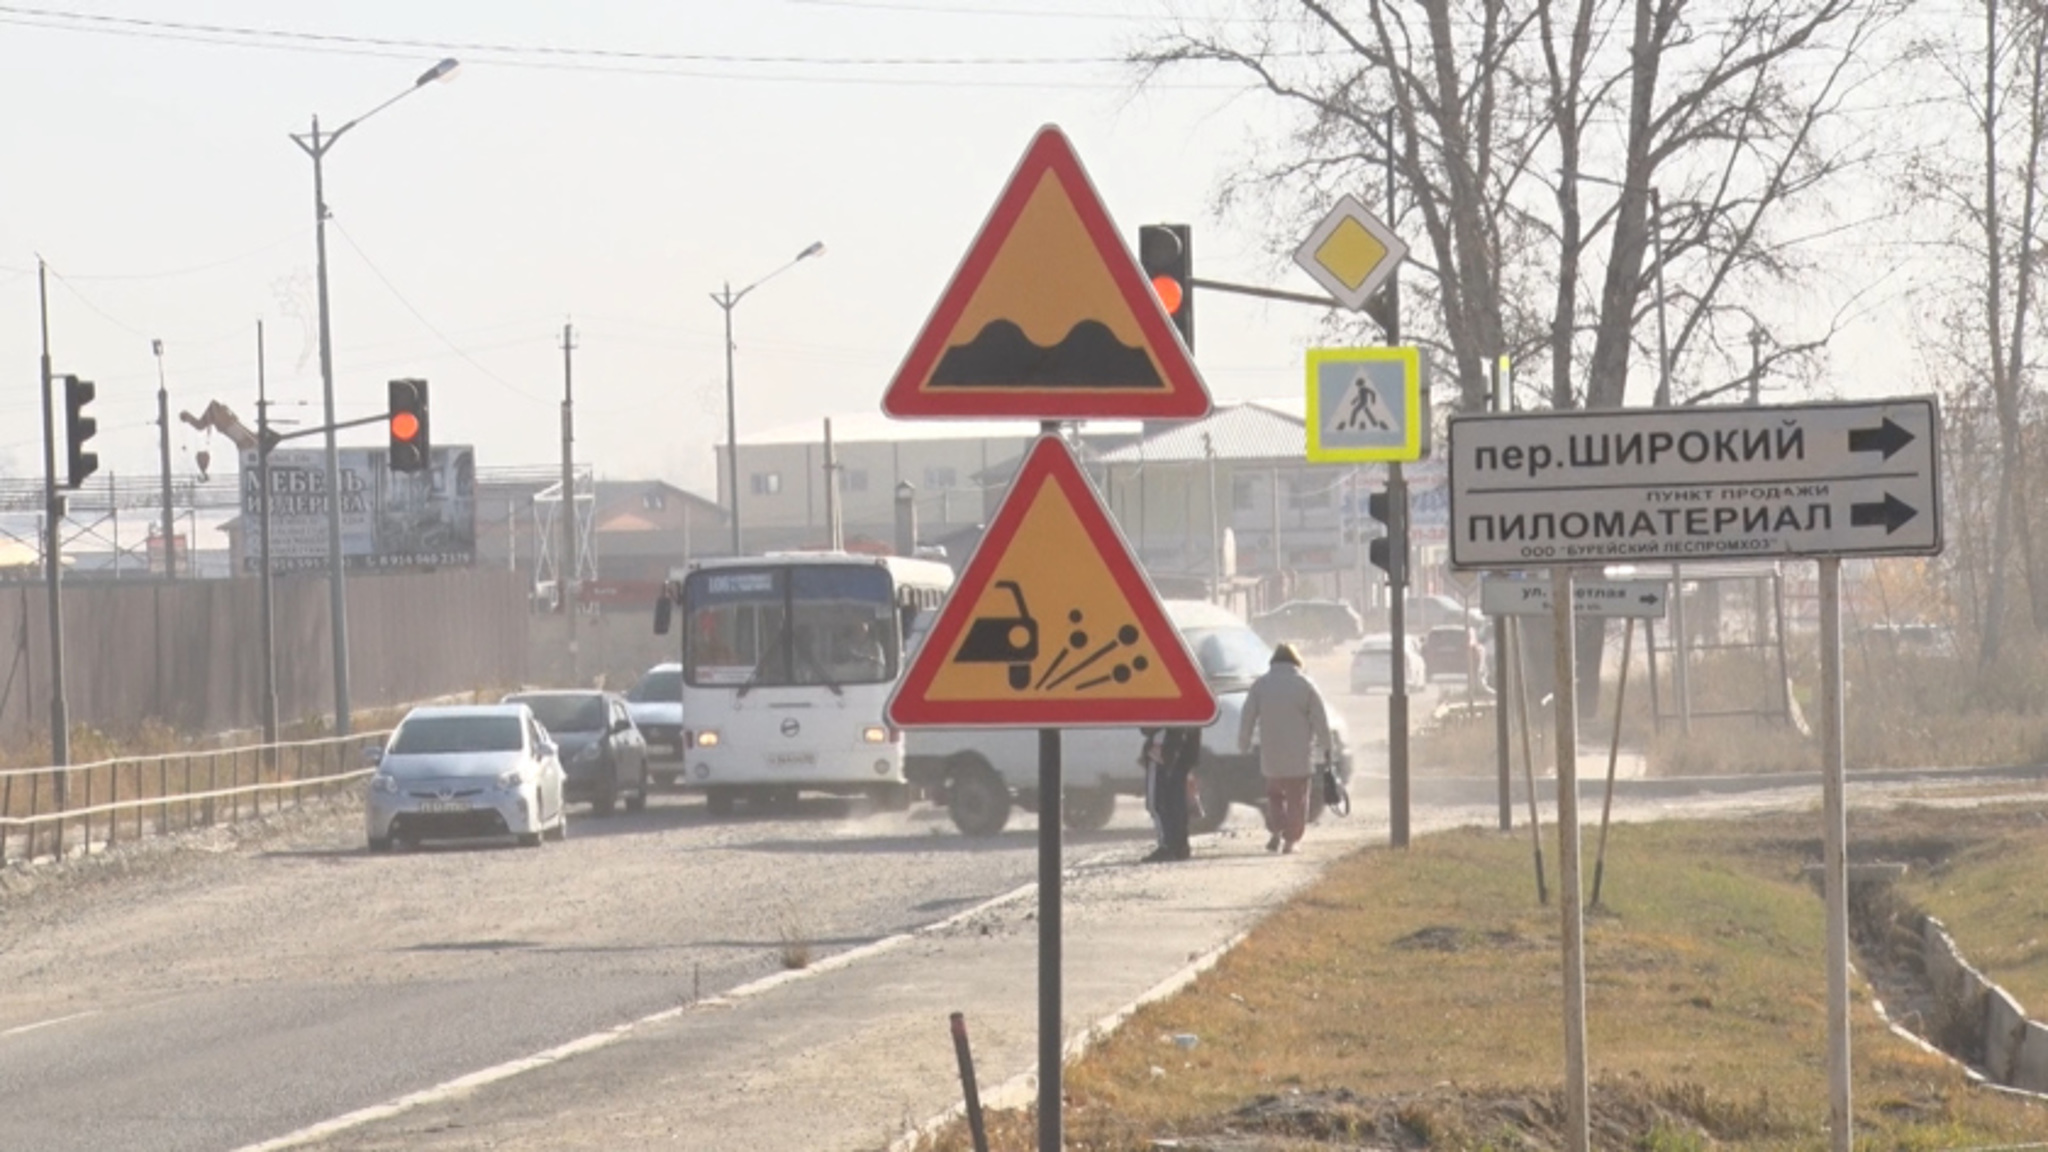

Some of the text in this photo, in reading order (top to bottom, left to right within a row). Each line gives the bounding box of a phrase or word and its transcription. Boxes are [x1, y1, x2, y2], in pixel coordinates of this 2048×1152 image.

[1475, 419, 1805, 477] пер.ШИРОКИЙ
[247, 469, 363, 492] МЕБЕЬ
[1646, 484, 1830, 503] ПУНКТ ПРОДАЖИ
[1469, 503, 1832, 541] ПИЛОМАТЕРИАЛ
[1520, 545, 1556, 557] ООО
[1522, 587, 1547, 600] ул.
